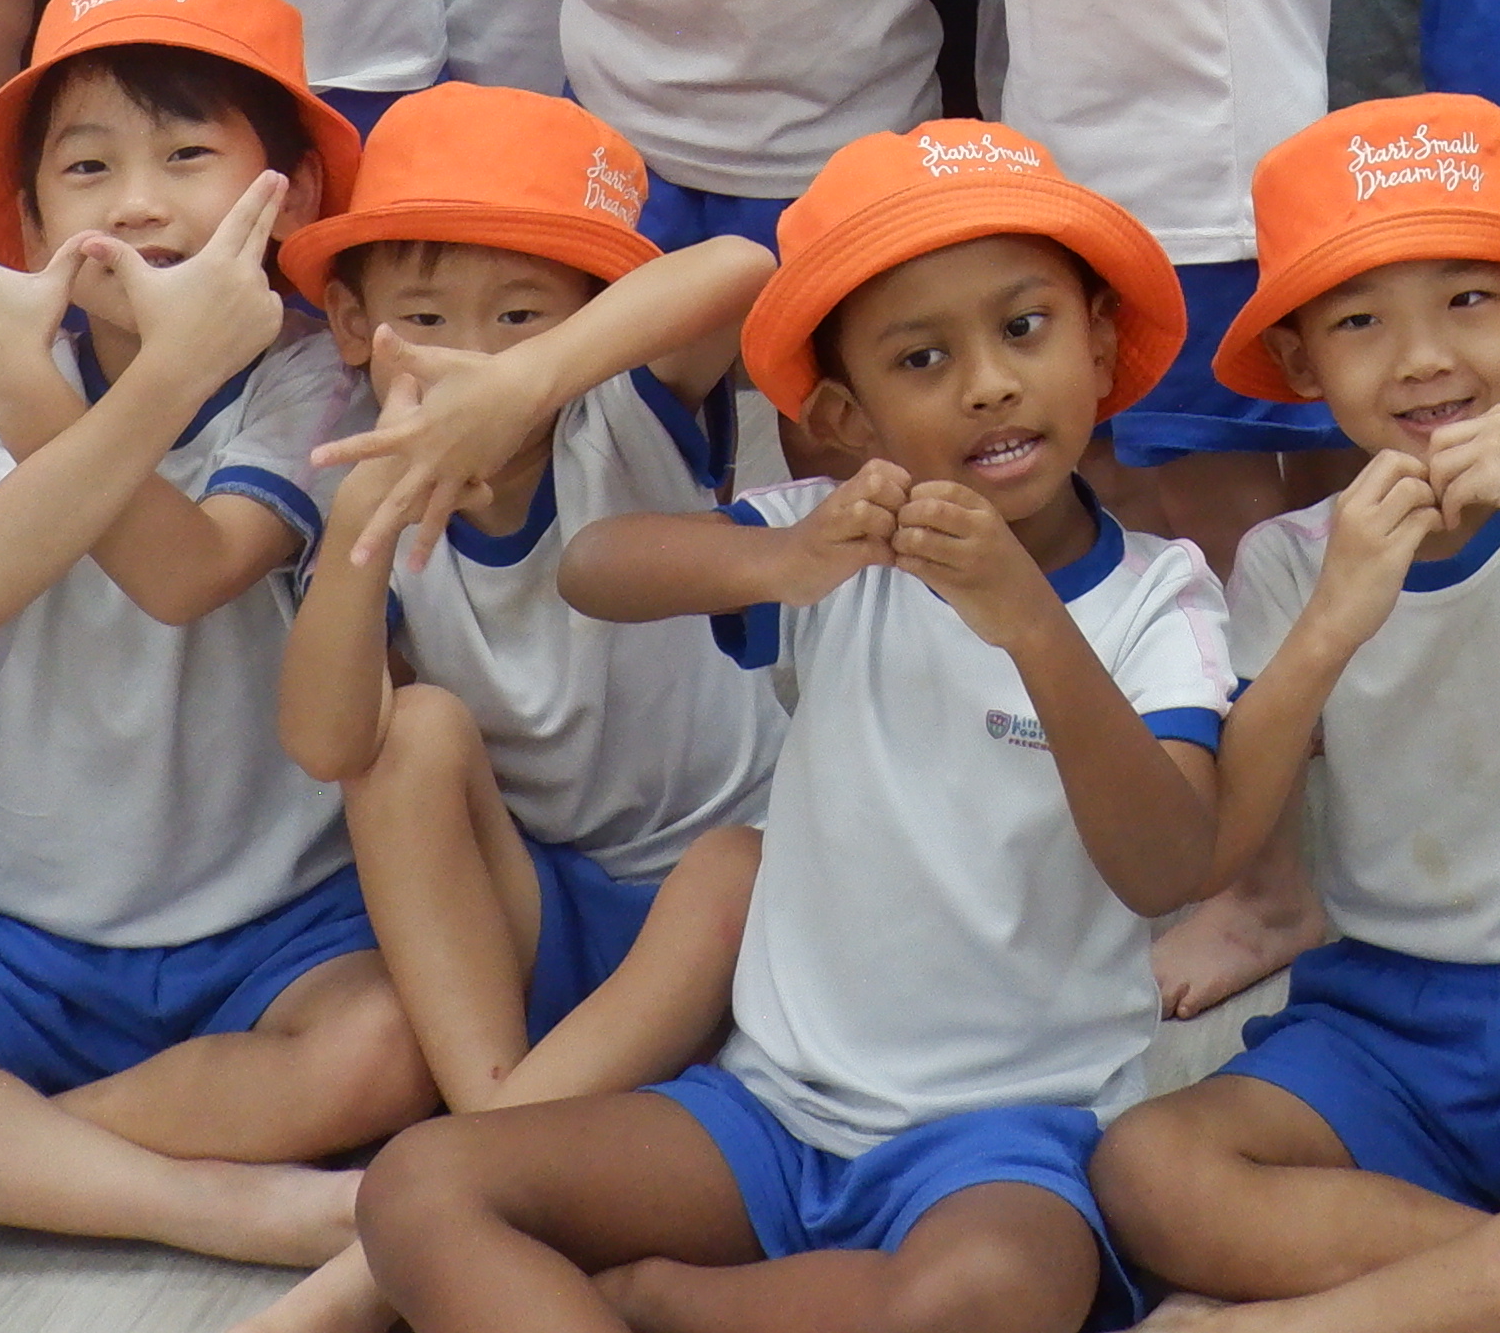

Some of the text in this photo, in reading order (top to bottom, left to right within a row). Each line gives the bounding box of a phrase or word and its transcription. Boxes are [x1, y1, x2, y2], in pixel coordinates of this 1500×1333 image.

[919, 134, 1040, 169] Start Small
[1348, 124, 1479, 169] Start Small
[1351, 153, 1484, 201] Dream Big
